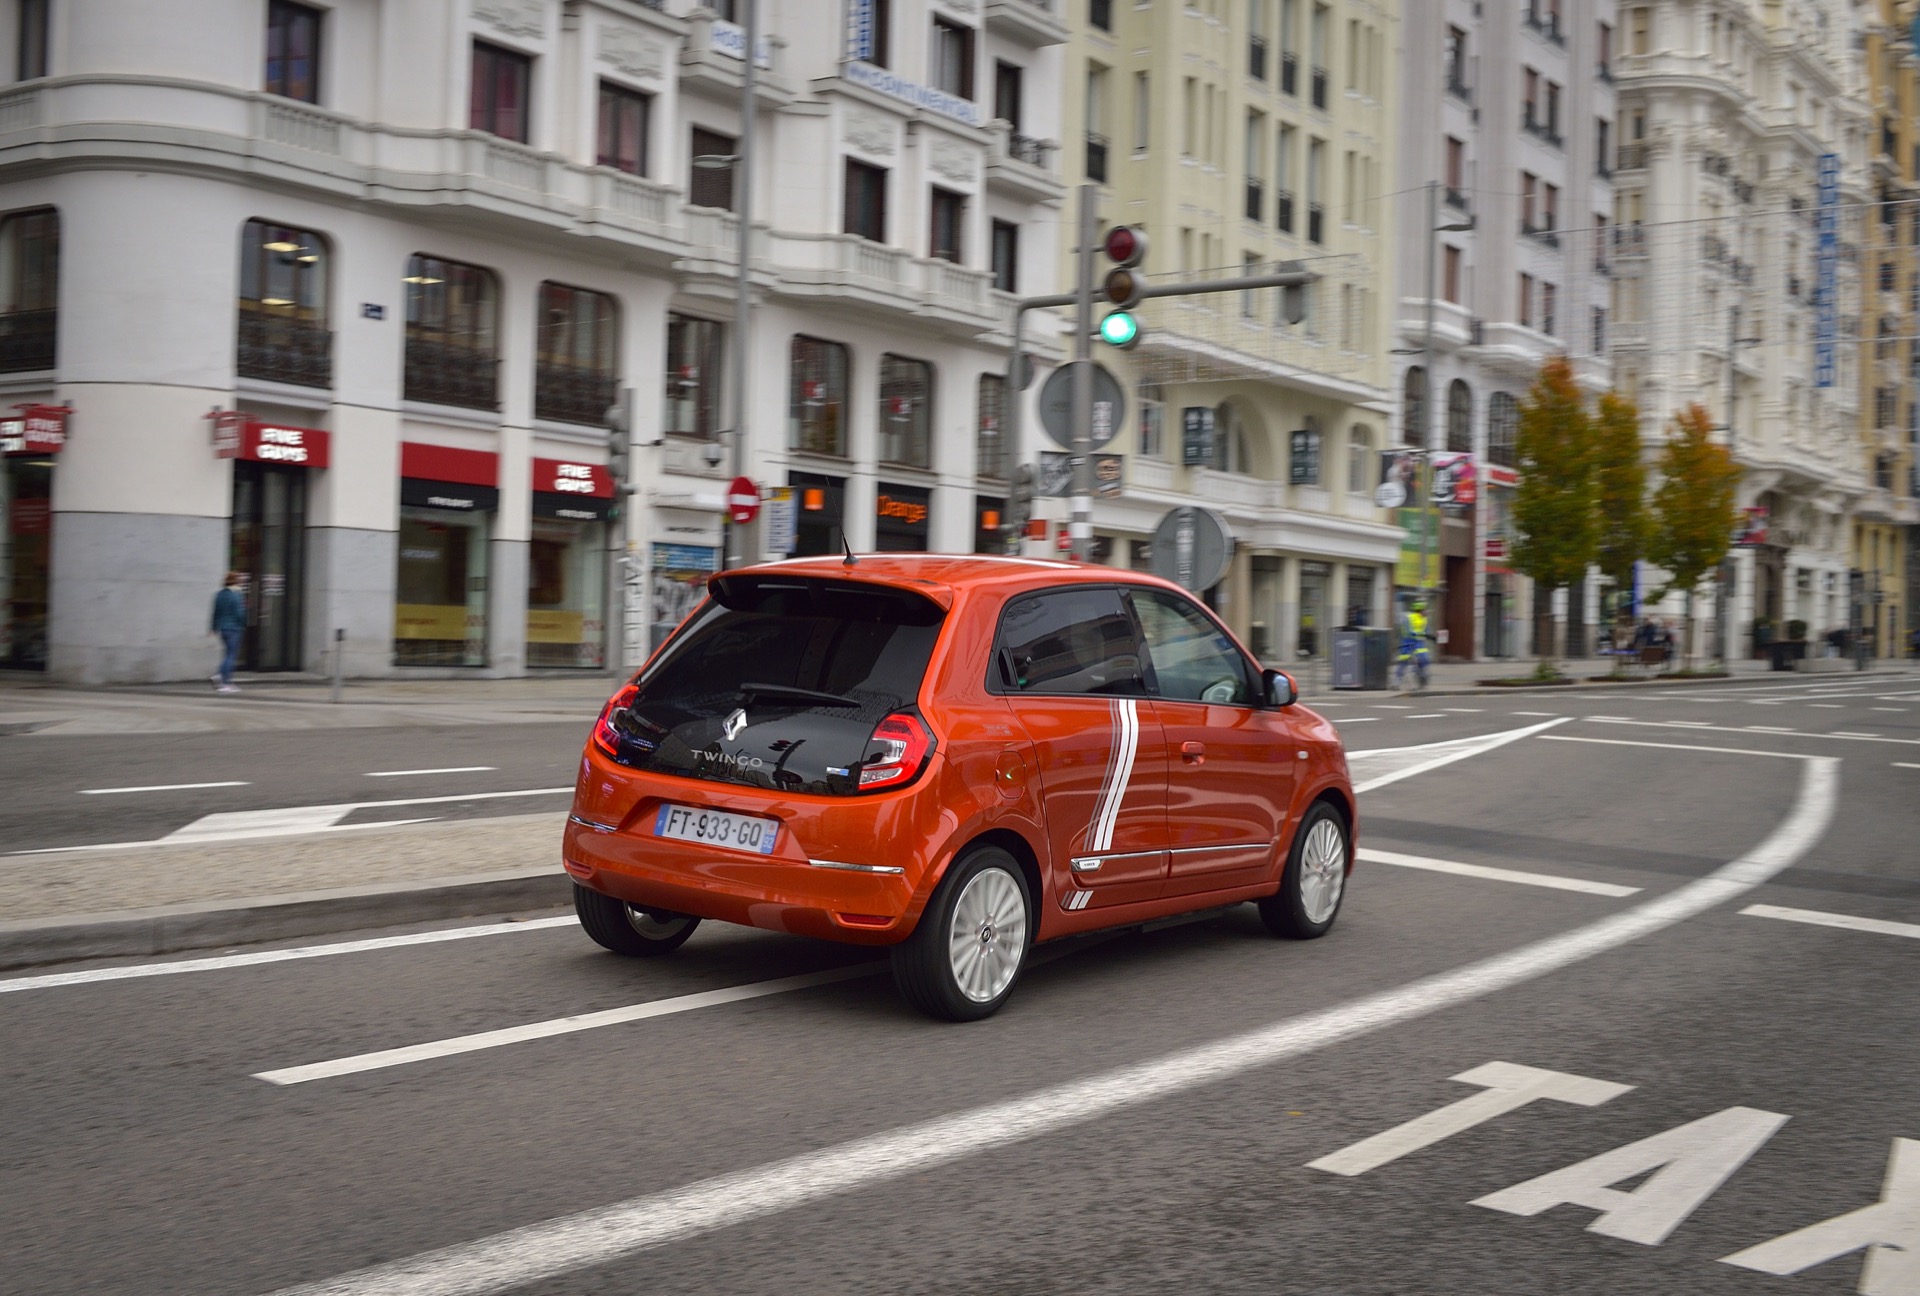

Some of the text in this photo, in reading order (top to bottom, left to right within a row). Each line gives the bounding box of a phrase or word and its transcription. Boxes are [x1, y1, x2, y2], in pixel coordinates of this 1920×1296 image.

[261, 428, 304, 445] FIVE
[256, 444, 309, 462] GUYS
[556, 464, 592, 479] FIVE
[554, 478, 596, 493] GUYS
[691, 749, 763, 768] TWINGO
